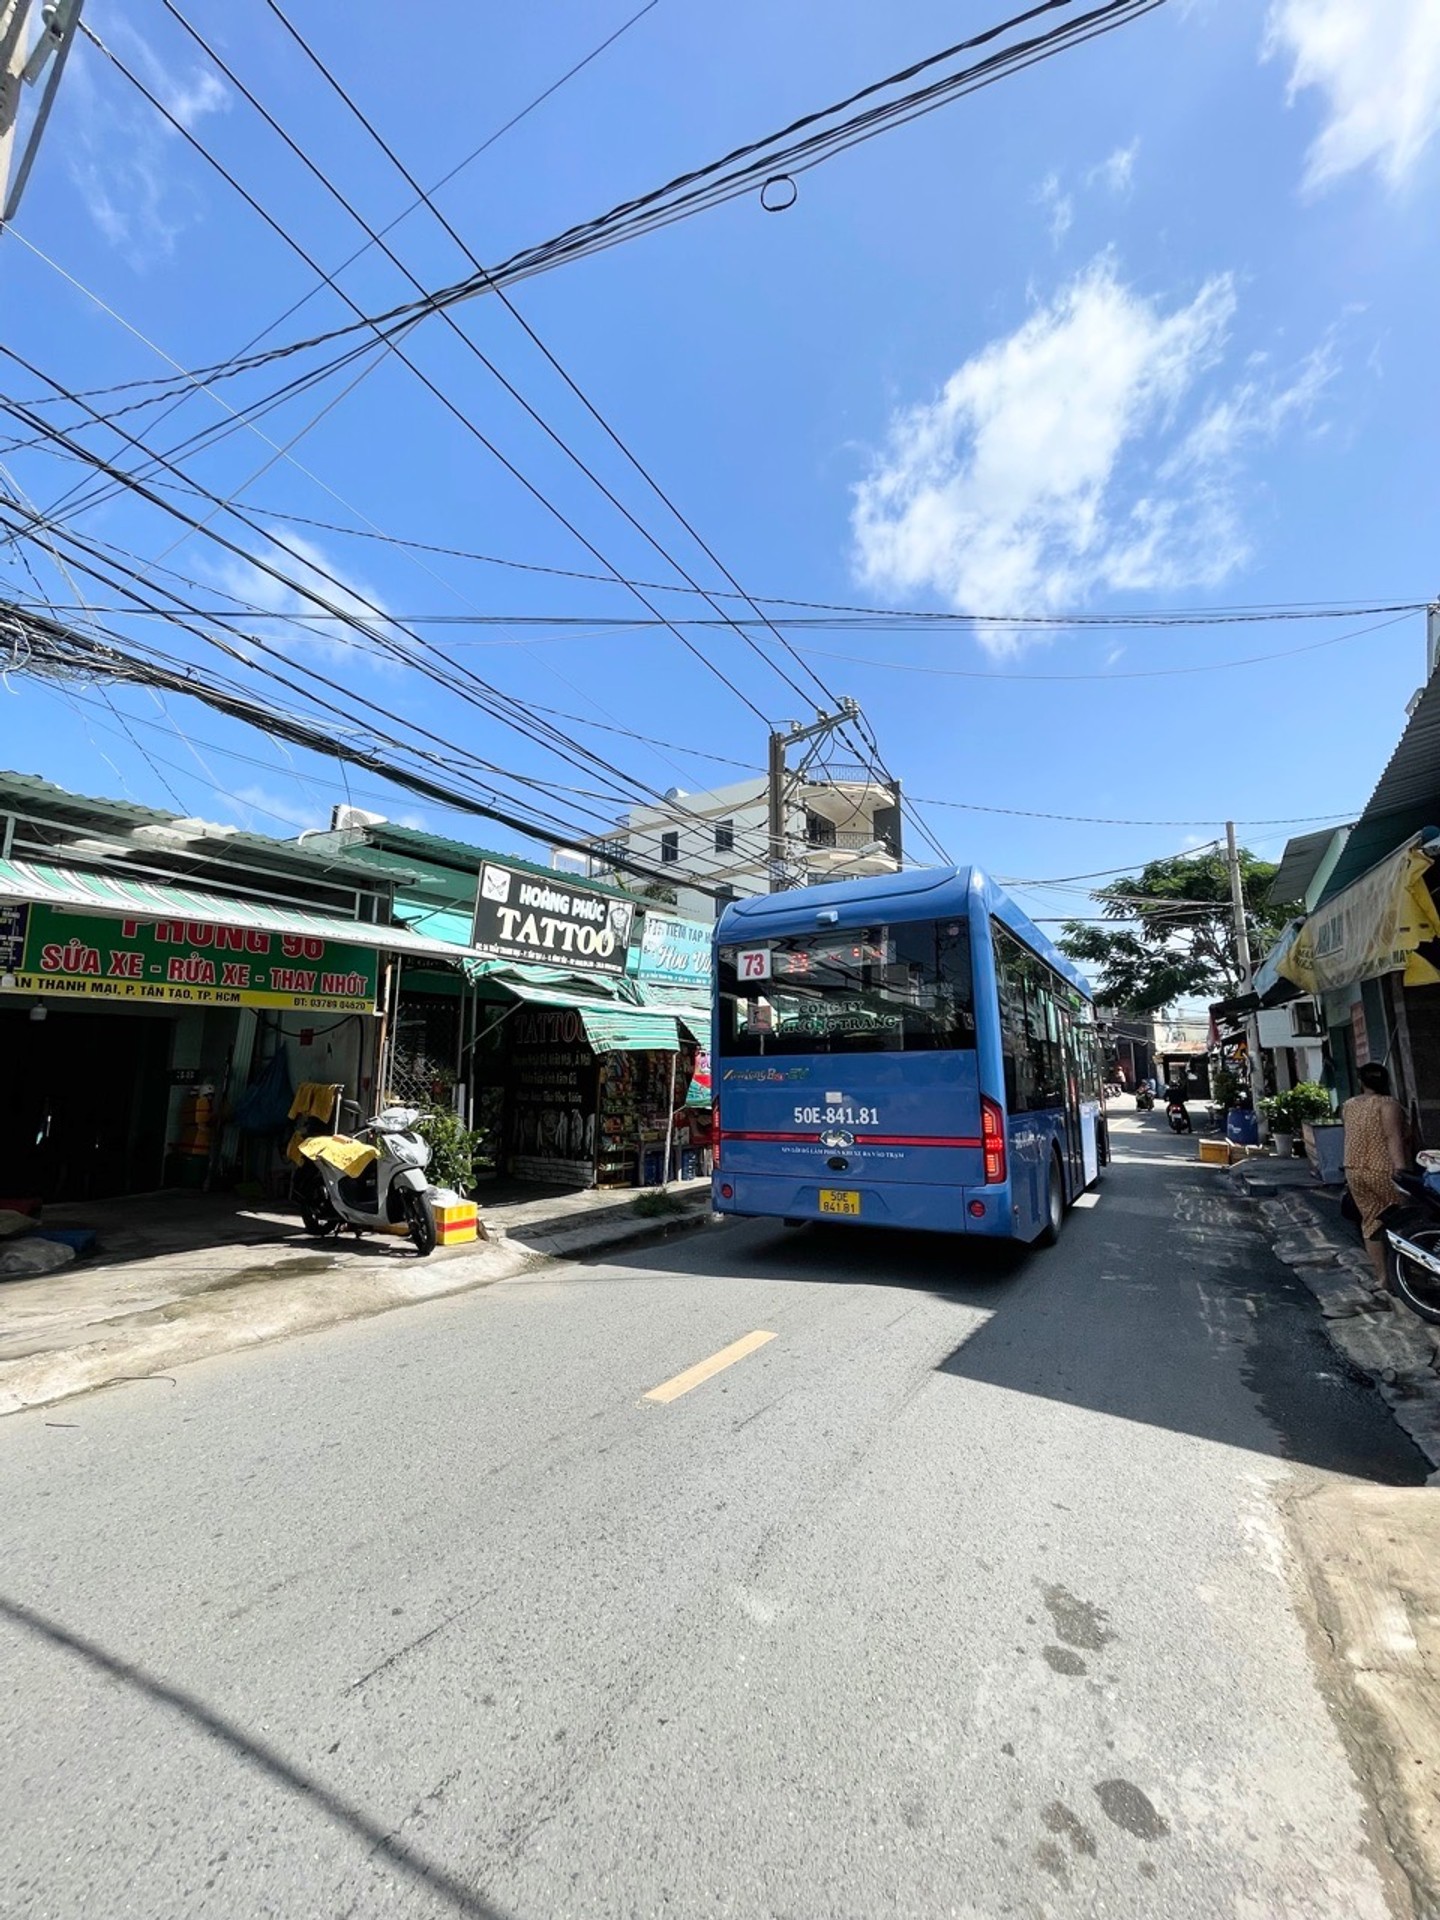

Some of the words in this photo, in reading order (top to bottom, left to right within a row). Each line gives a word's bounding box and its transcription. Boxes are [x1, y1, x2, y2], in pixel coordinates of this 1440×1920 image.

[519, 883, 570, 915] HOÀNG
[572, 896, 606, 922] PHÚC
[497, 906, 616, 958] TATTOO
[40, 938, 101, 975] SỬA
[107, 950, 145, 979] XE
[167, 951, 216, 984] RỬA
[220, 962, 251, 987] XE
[270, 967, 317, 992] THAY
[320, 971, 368, 996] NHỚT
[744, 953, 765, 977] 73
[37, 978, 86, 992] THANH
[216, 993, 240, 1002] HCM
[794, 1107, 879, 1125] 50E-841.81
[831, 1192, 848, 1202] 50E
